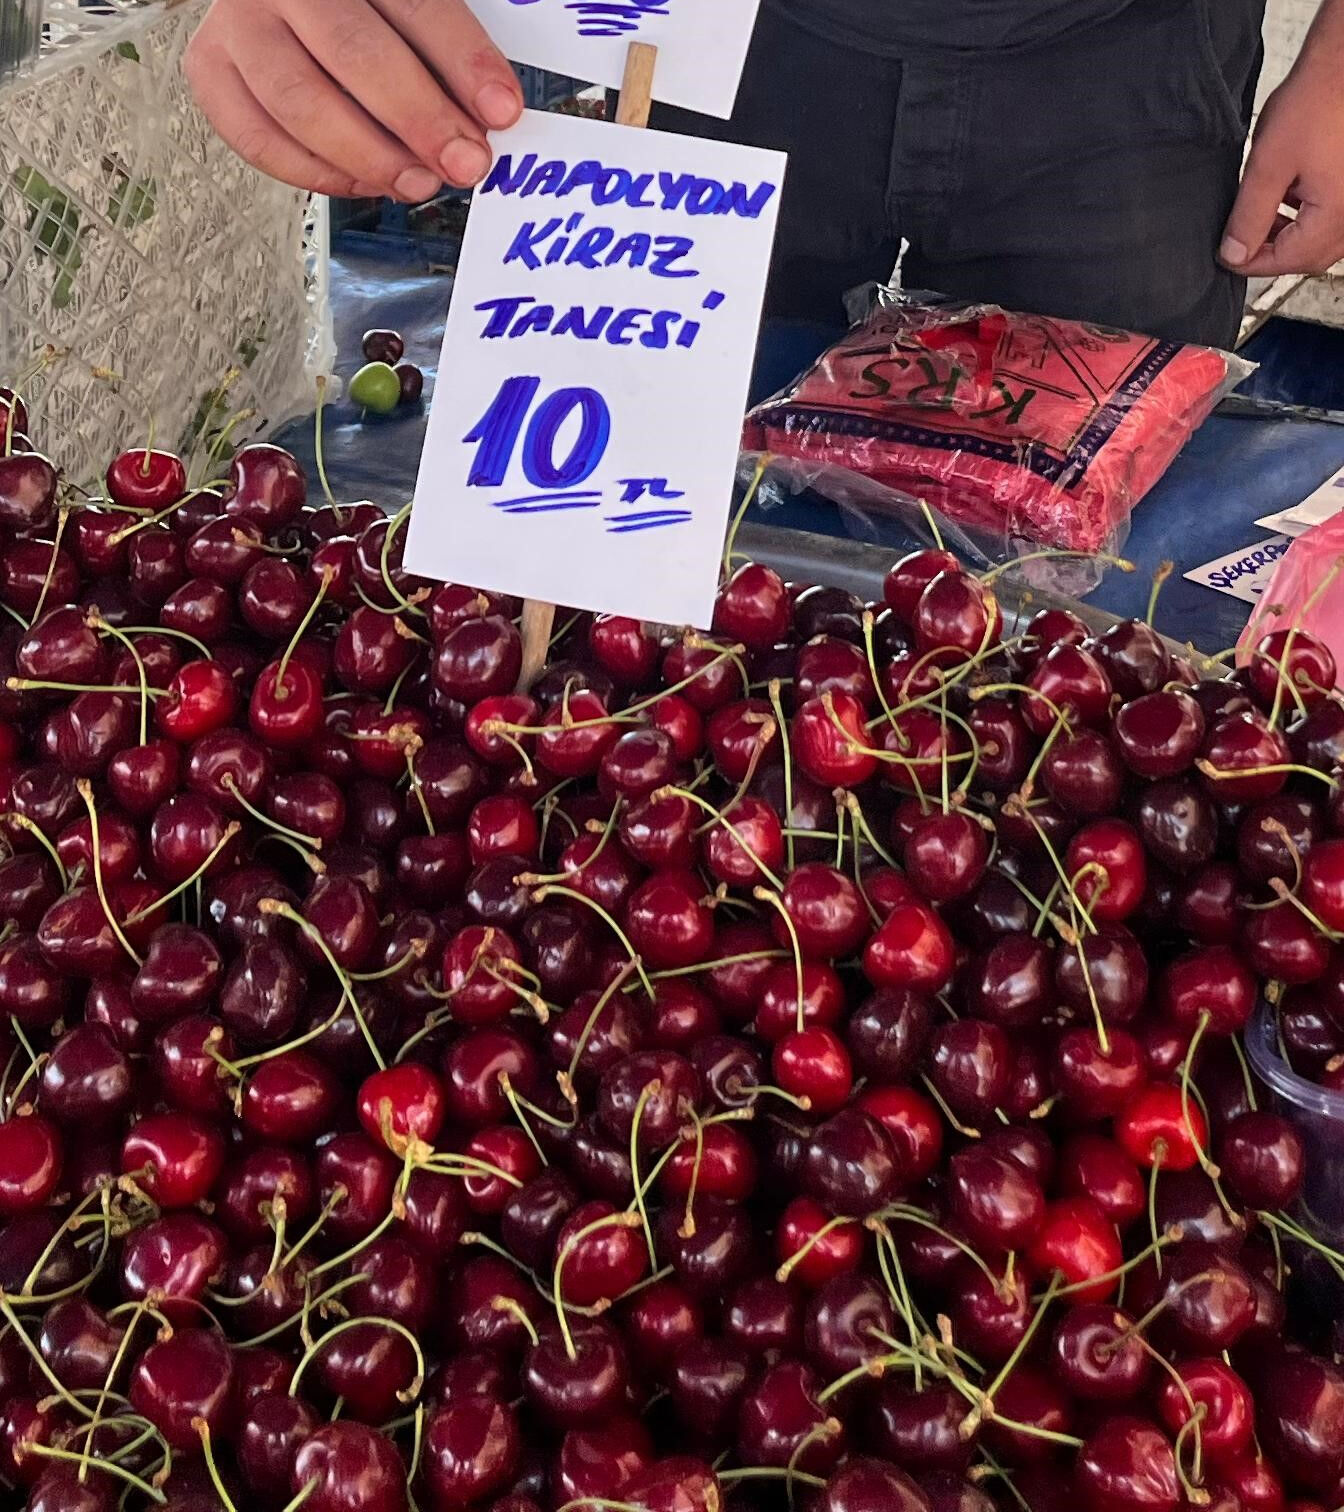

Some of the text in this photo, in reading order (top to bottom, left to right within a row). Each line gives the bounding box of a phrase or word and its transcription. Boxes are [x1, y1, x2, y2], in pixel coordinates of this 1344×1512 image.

[480, 154, 776, 218] NAPOLYON
[502, 212, 700, 278] KİRAZ
[474, 291, 725, 349] TANESİ
[462, 376, 611, 488] 10
